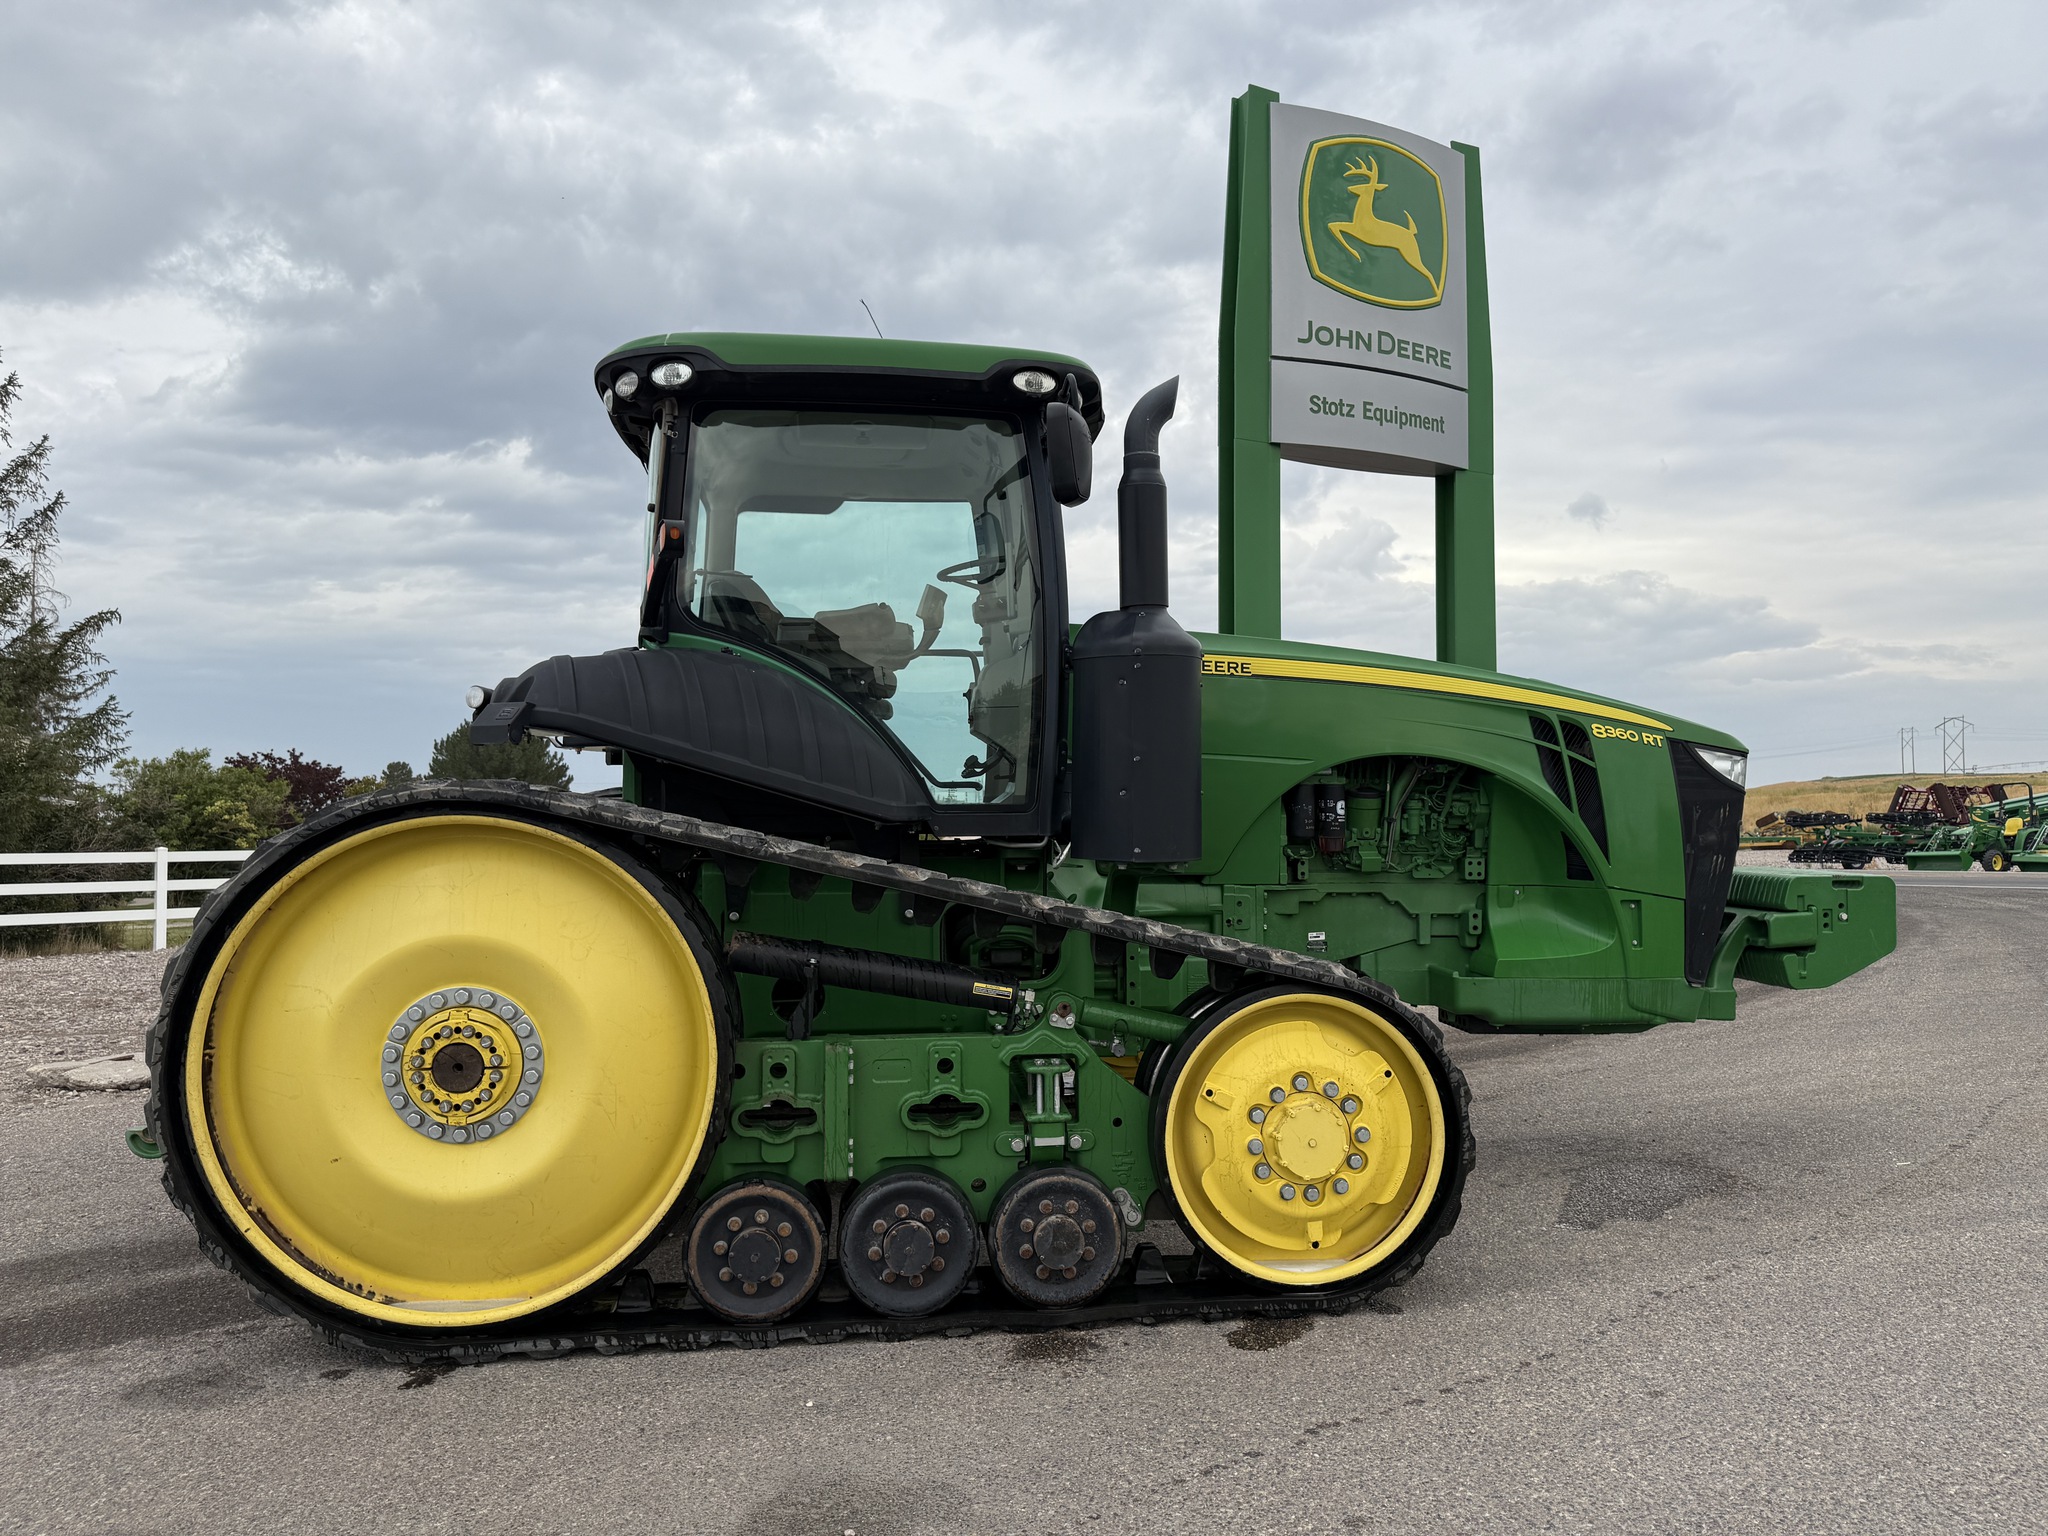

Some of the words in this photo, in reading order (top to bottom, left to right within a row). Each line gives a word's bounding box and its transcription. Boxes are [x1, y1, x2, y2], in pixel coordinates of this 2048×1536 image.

[1297, 320, 1372, 352] JOHN
[1377, 330, 1452, 370] DEERE
[1309, 394, 1355, 418] Stotz
[1362, 401, 1445, 434] Equipment
[1201, 660, 1252, 674] EERE
[1591, 723, 1639, 742] 8360
[1641, 732, 1664, 747] RT
